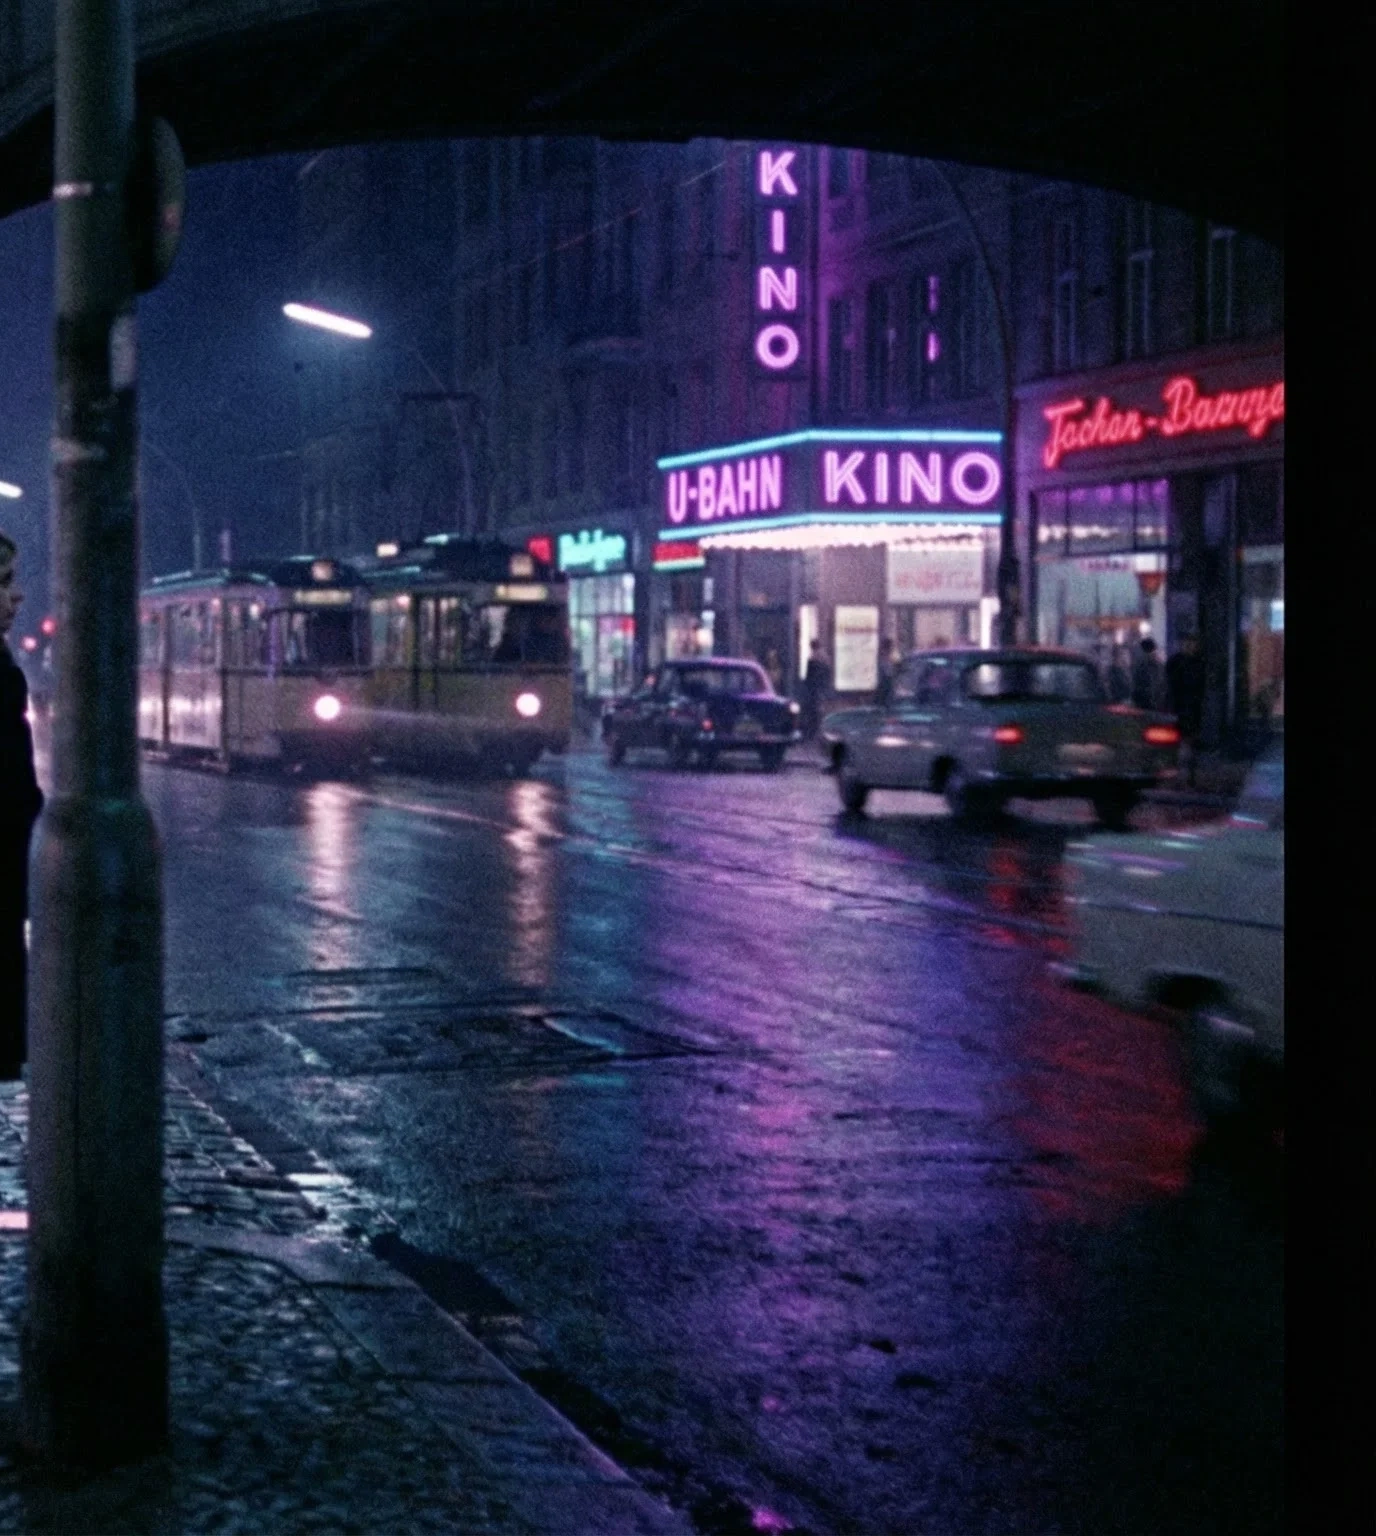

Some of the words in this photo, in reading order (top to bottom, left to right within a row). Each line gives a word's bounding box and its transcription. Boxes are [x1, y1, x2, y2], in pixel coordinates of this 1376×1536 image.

[756, 150, 799, 369] KINO
[668, 455, 781, 523] U-BAHN
[825, 451, 1001, 504] KINO
